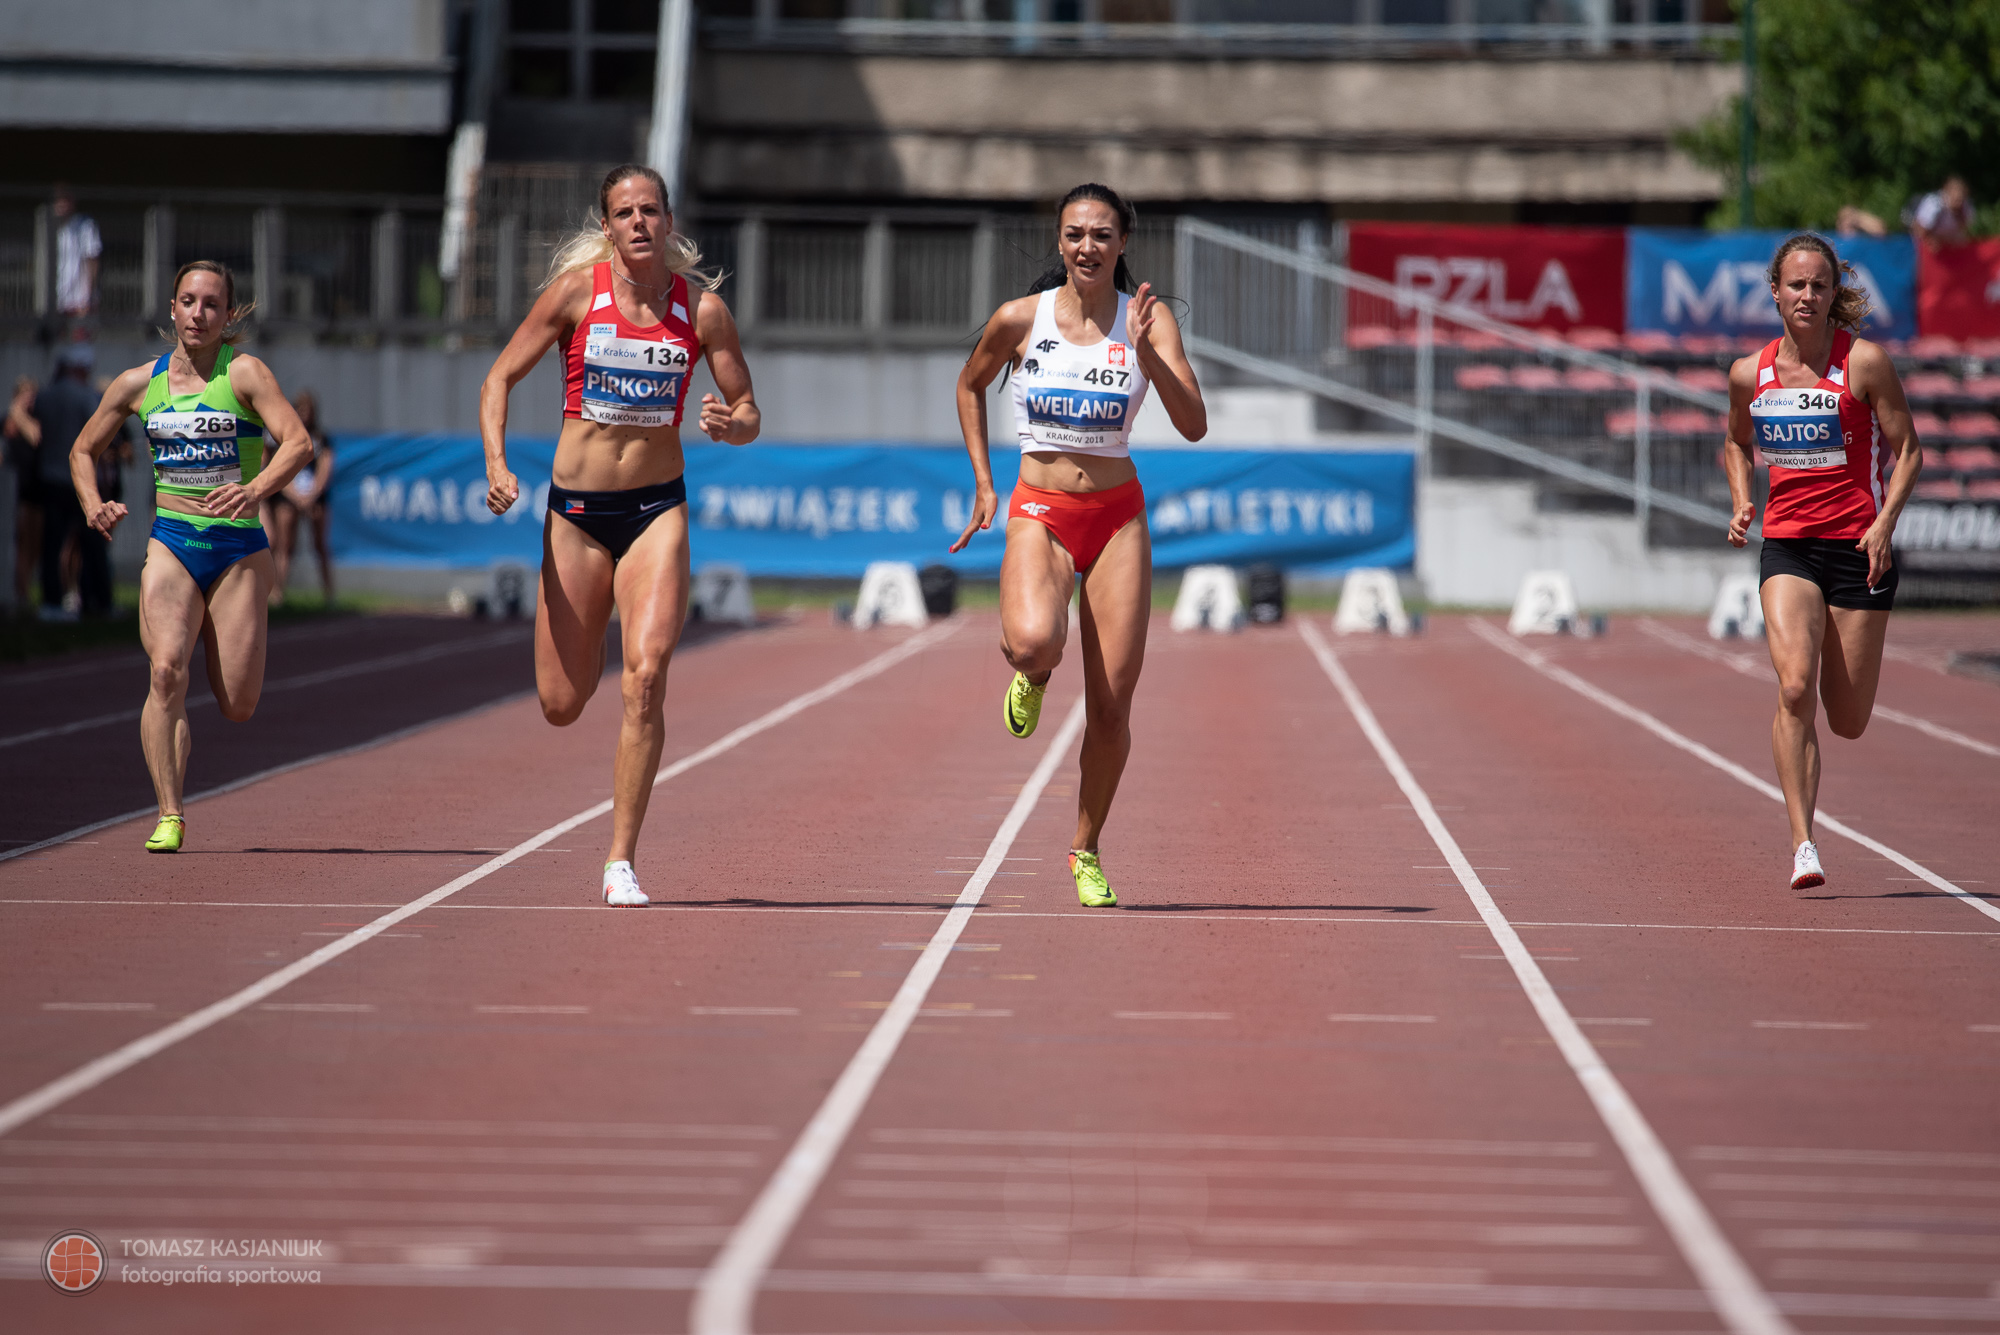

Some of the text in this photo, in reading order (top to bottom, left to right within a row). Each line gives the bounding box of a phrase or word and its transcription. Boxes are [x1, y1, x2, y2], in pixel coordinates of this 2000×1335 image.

[1036, 339, 1059, 353] 4F
[603, 346, 687, 367] Kraków 134
[587, 371, 678, 398] PÍRKOVÁ
[1047, 368, 1129, 387] Kraków 467
[1030, 395, 1123, 419] WEILAND
[1765, 393, 1837, 410] Kraków 346
[599, 411, 639, 422] KRAKÓW
[161, 417, 235, 433] Kraków 263
[1762, 423, 1830, 442] SAJTOS
[1046, 432, 1082, 443] KRAKÓW
[157, 440, 236, 461] ZALOKAR
[1775, 456, 1828, 465] KRAKÓW 2018
[169, 475, 224, 484] KRAKÓW 2018
[1020, 502, 1051, 516] 4F
